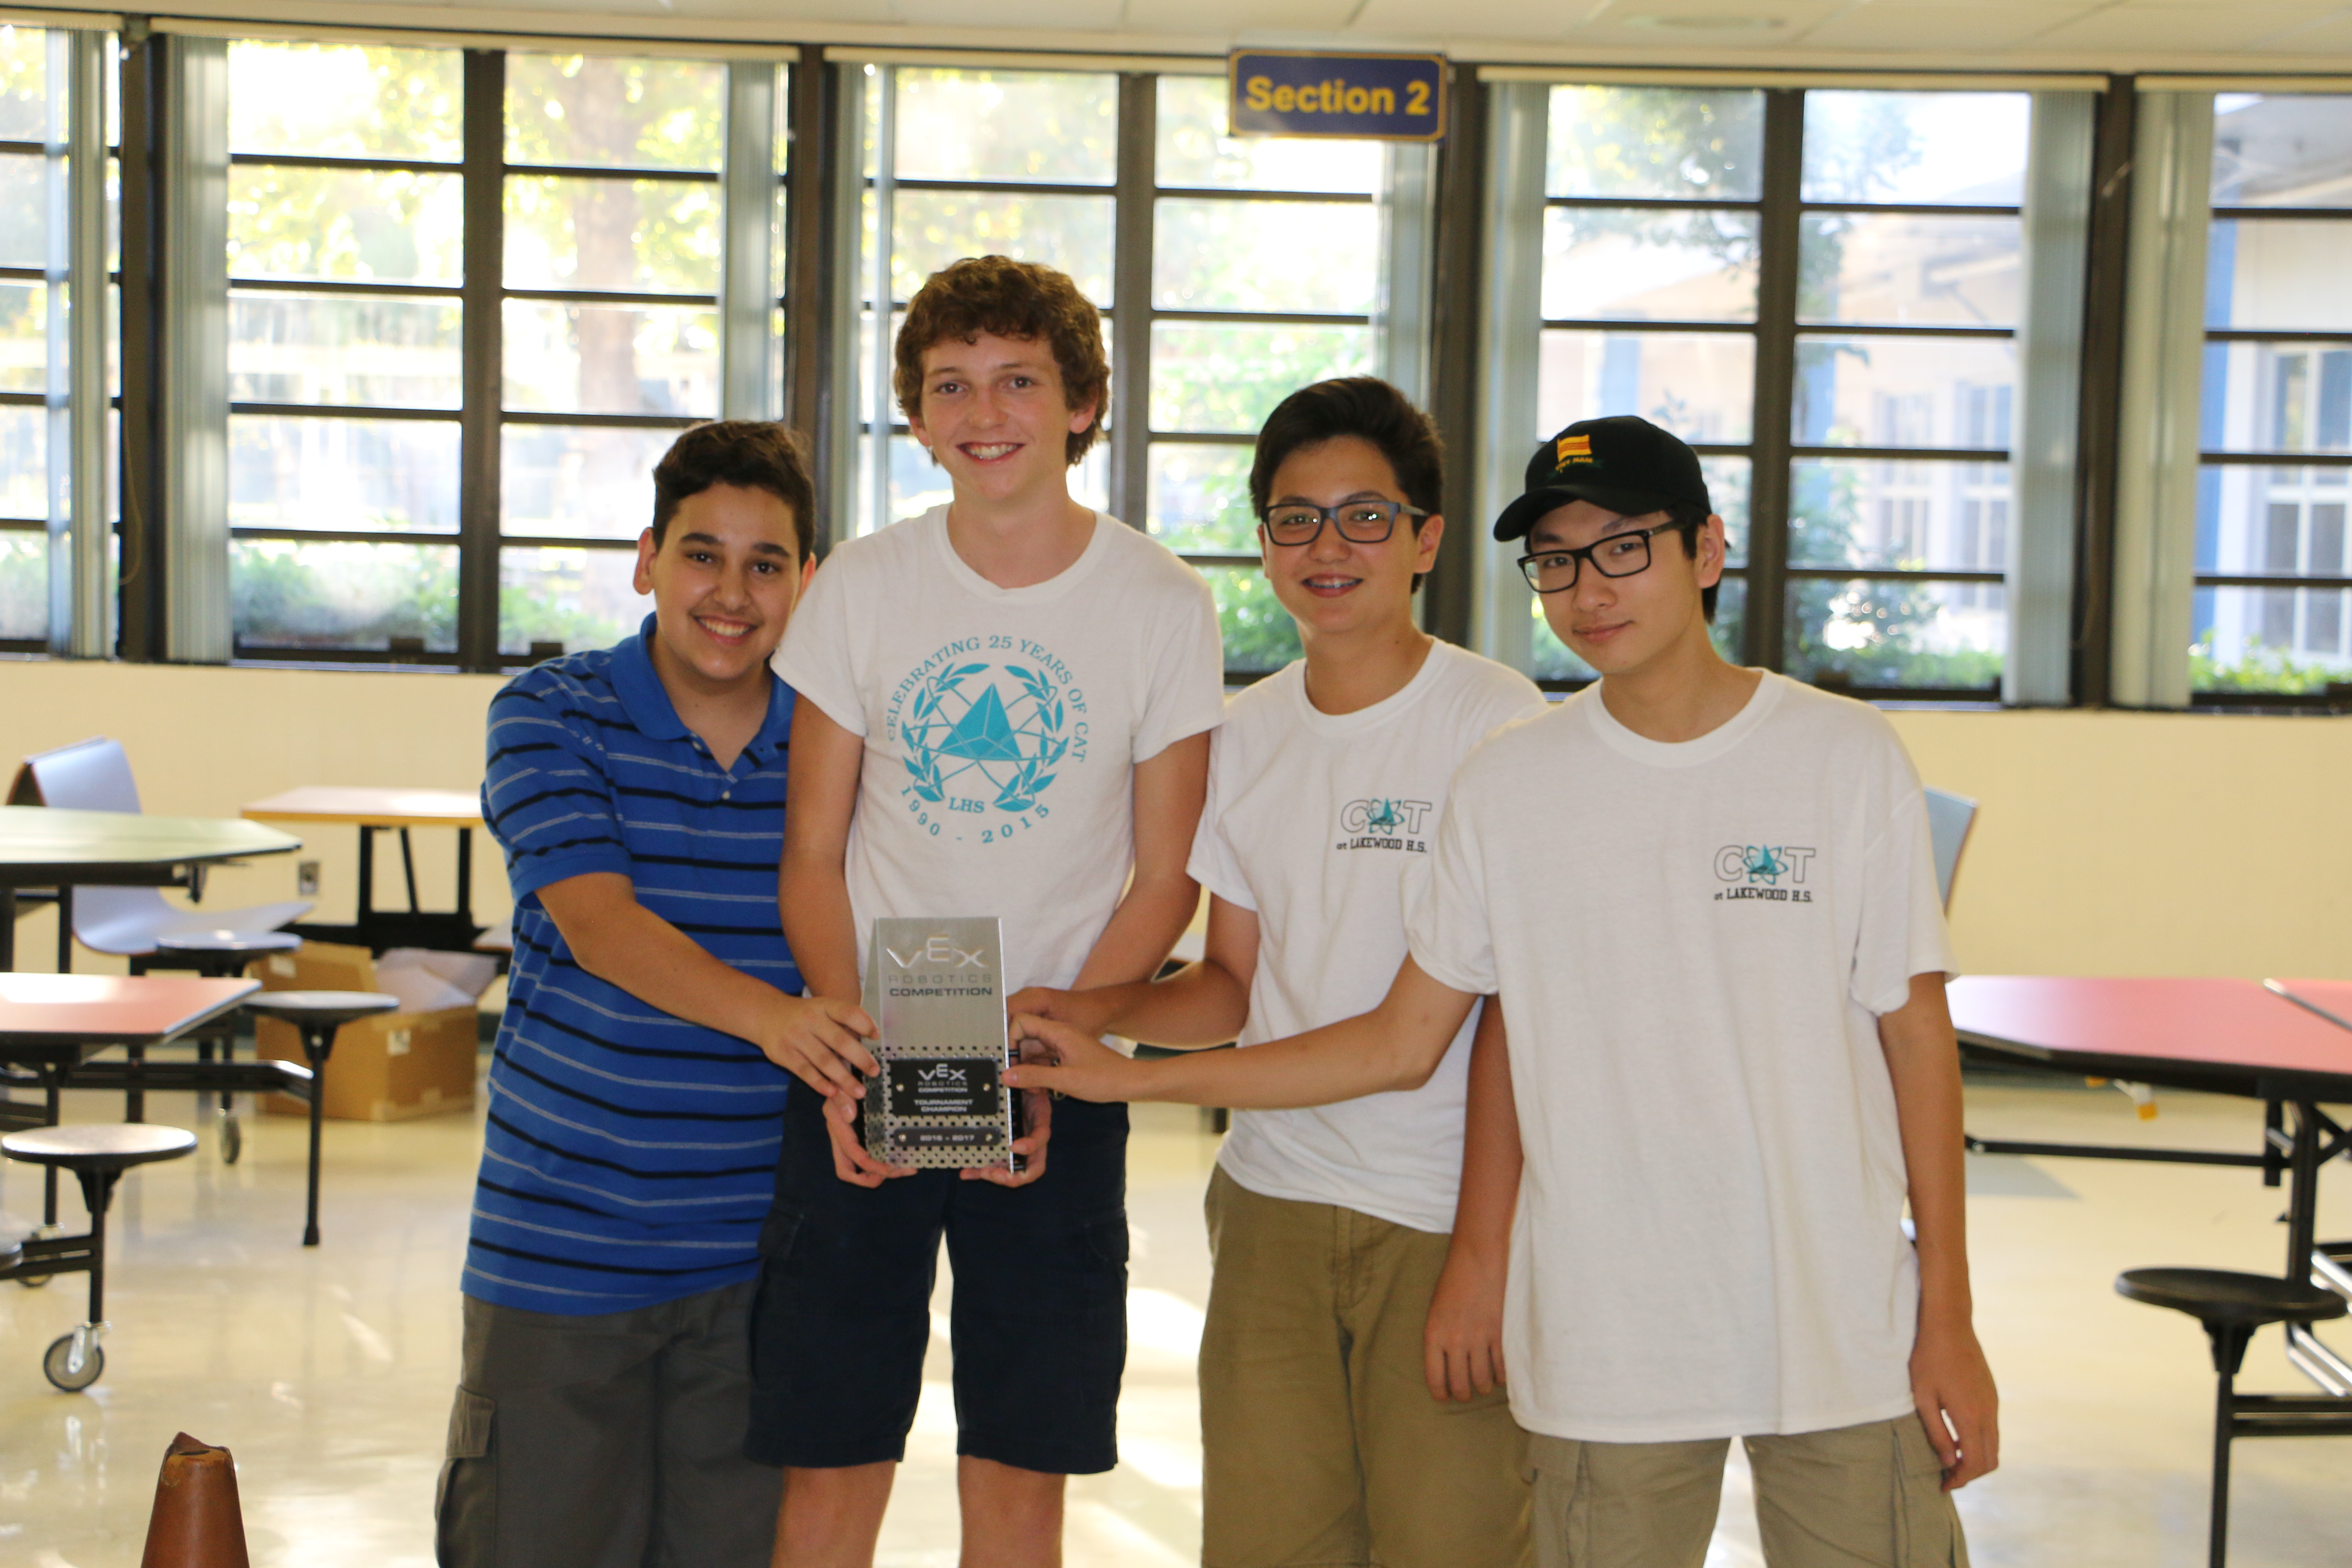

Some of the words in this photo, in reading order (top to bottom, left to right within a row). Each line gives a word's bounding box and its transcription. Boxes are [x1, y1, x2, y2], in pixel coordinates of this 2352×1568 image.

[1246, 76, 1395, 115] Section
[1405, 80, 1430, 115] 2
[989, 636, 1012, 649] 25
[1020, 639, 1073, 685] YEARS
[887, 637, 980, 741] CELEBRATING
[1068, 689, 1087, 714] OF
[1072, 722, 1088, 763] CAT
[901, 786, 940, 836] 1990
[981, 804, 1049, 843] 2015
[949, 797, 985, 813] LHS
[1350, 837, 1402, 849] LAKEWOOD
[1727, 887, 1788, 900] LAKEWOOD
[886, 936, 986, 968] VEX
[888, 974, 992, 984] ROBOTICS
[889, 988, 993, 997] COMPETITION
[918, 1063, 967, 1081] VEX
